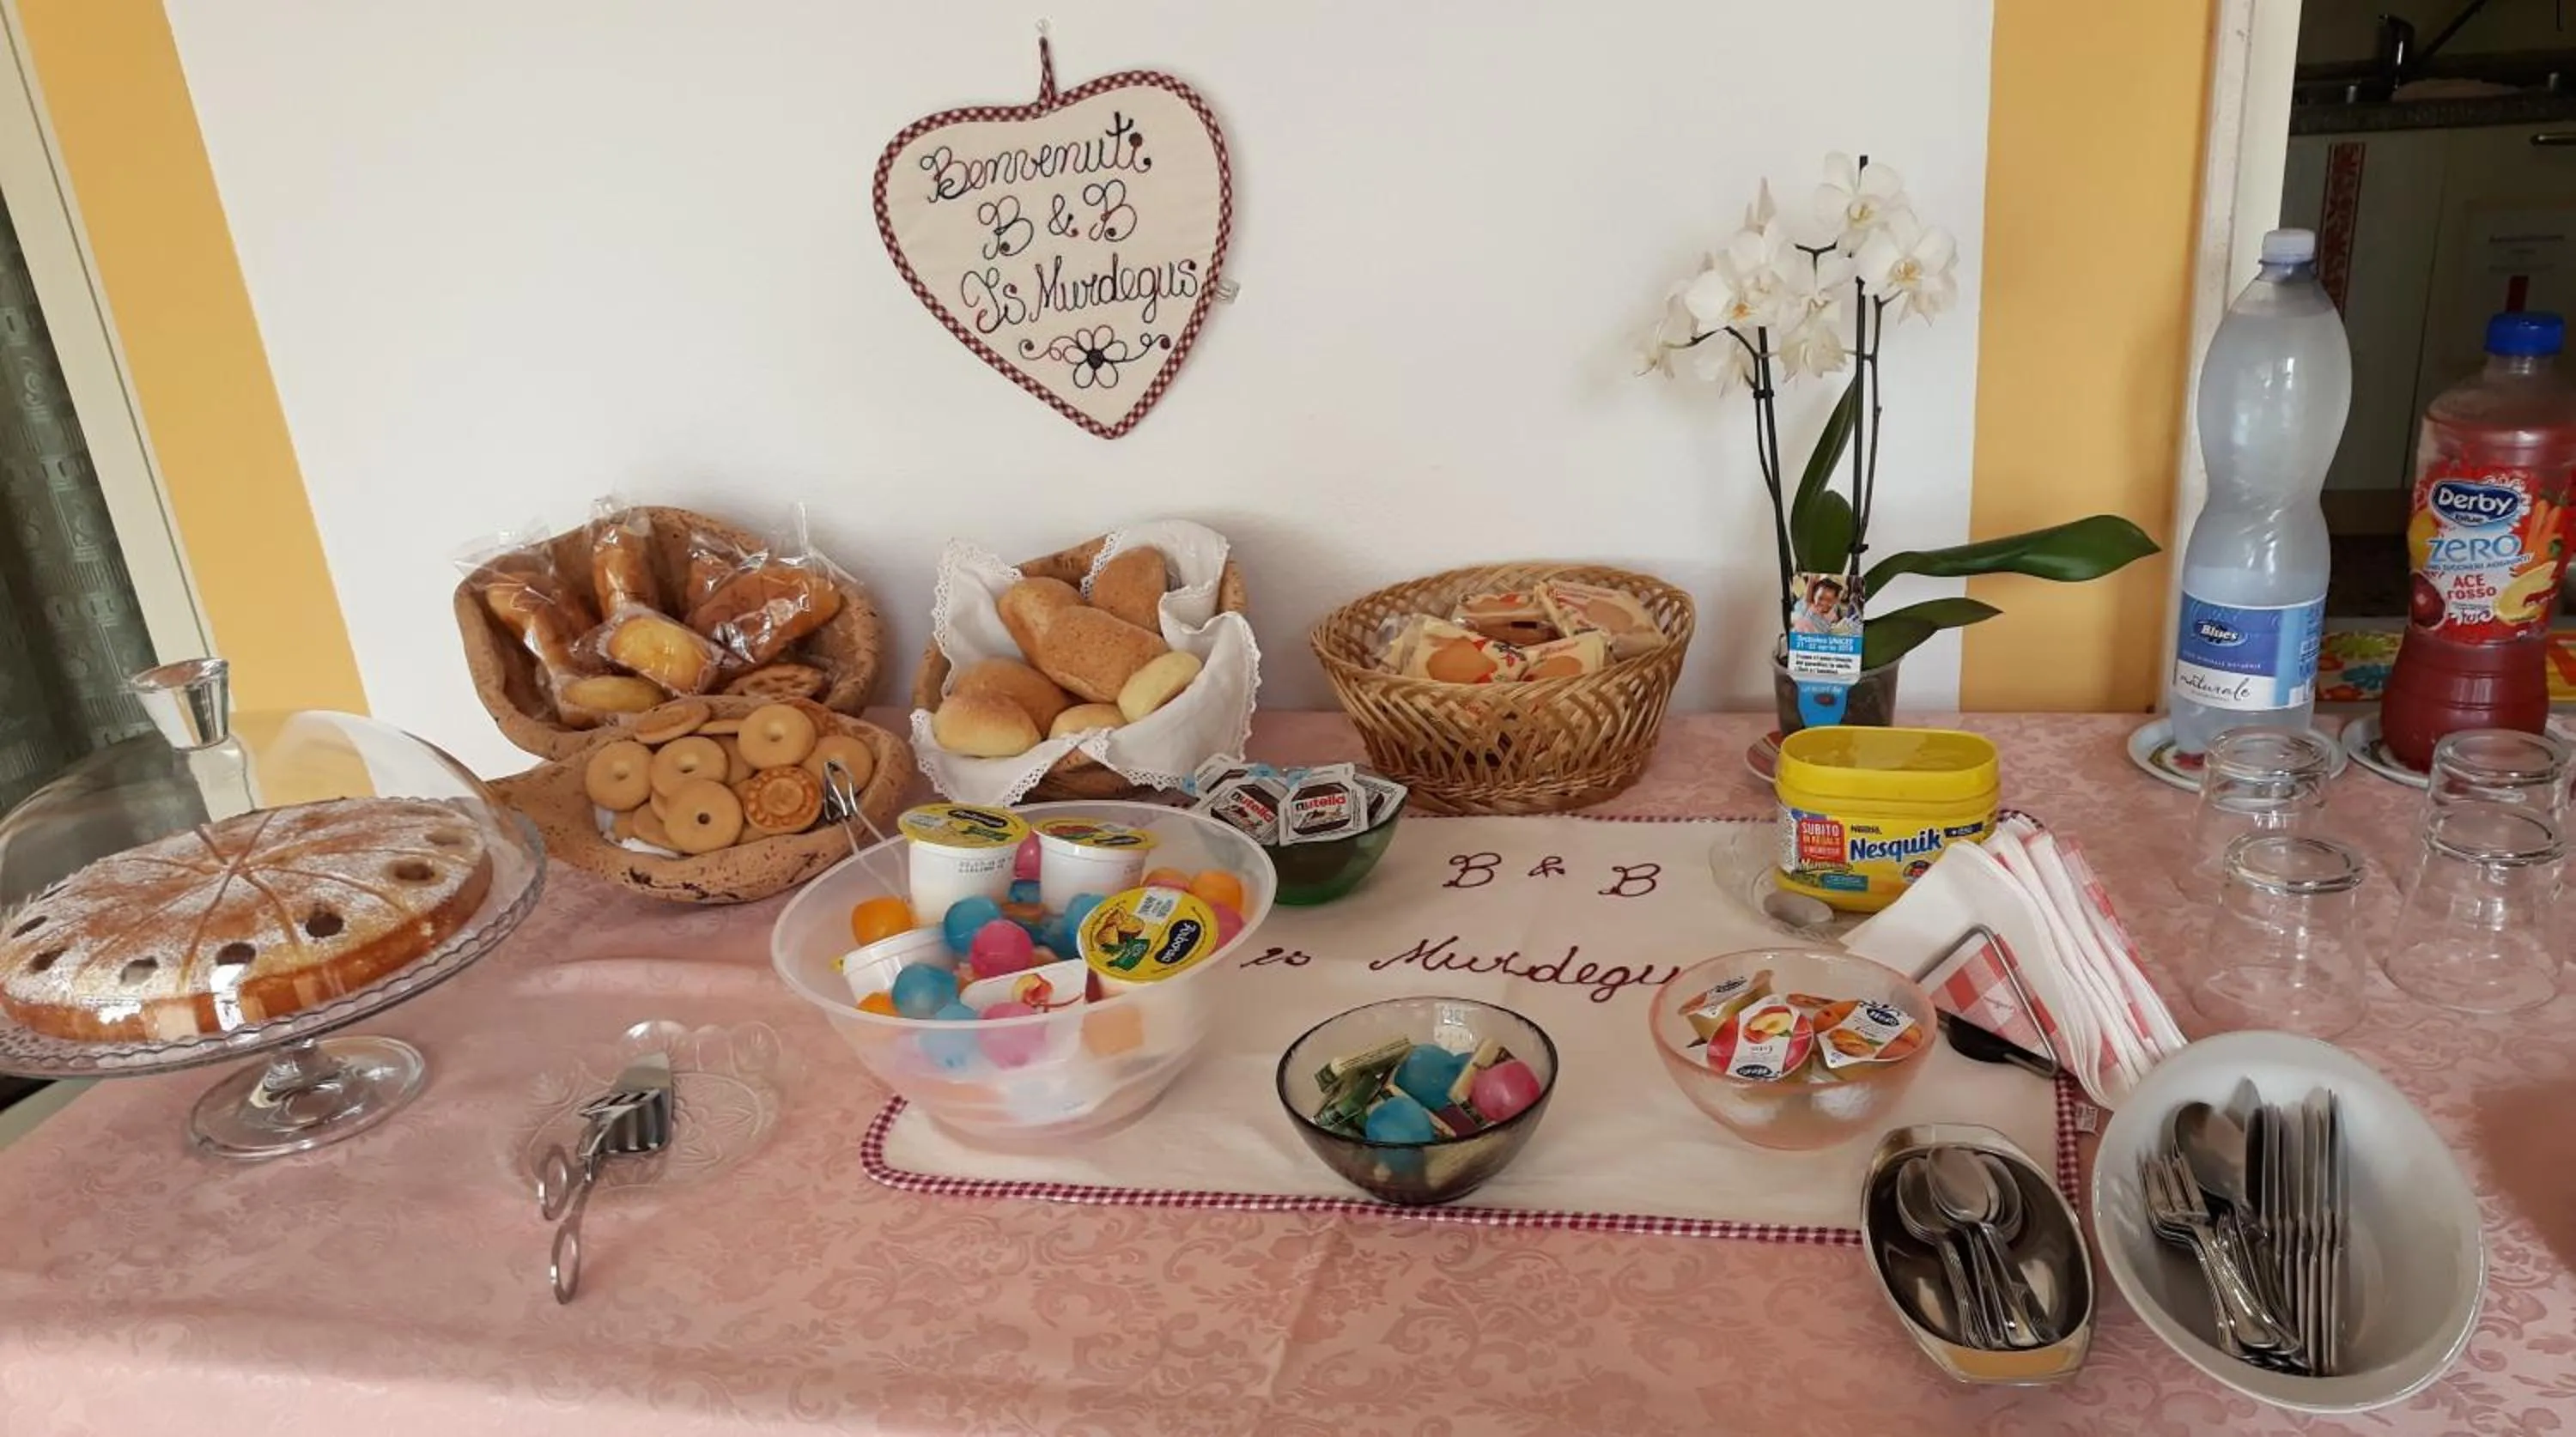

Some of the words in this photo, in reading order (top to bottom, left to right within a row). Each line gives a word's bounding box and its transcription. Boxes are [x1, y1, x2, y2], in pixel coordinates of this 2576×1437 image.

[920, 112, 1151, 203] Benvenuti
[978, 195, 1034, 259] B
[1048, 194, 1079, 237] &
[1083, 179, 1137, 241] B
[1029, 252, 1199, 323] Murdegus
[2438, 488, 2513, 515] Derby
[2453, 573, 2486, 588] ACE
[2201, 624, 2239, 642] Blues
[1230, 791, 1276, 824] nutella
[1295, 795, 1346, 812] nutella
[1801, 822, 1840, 837] SUBITO
[1850, 828, 1941, 862] Nesquik
[1443, 852, 1502, 888] B
[1528, 856, 1564, 877] &
[1598, 863, 1661, 897] B
[1369, 936, 1680, 1003] Murdegu
